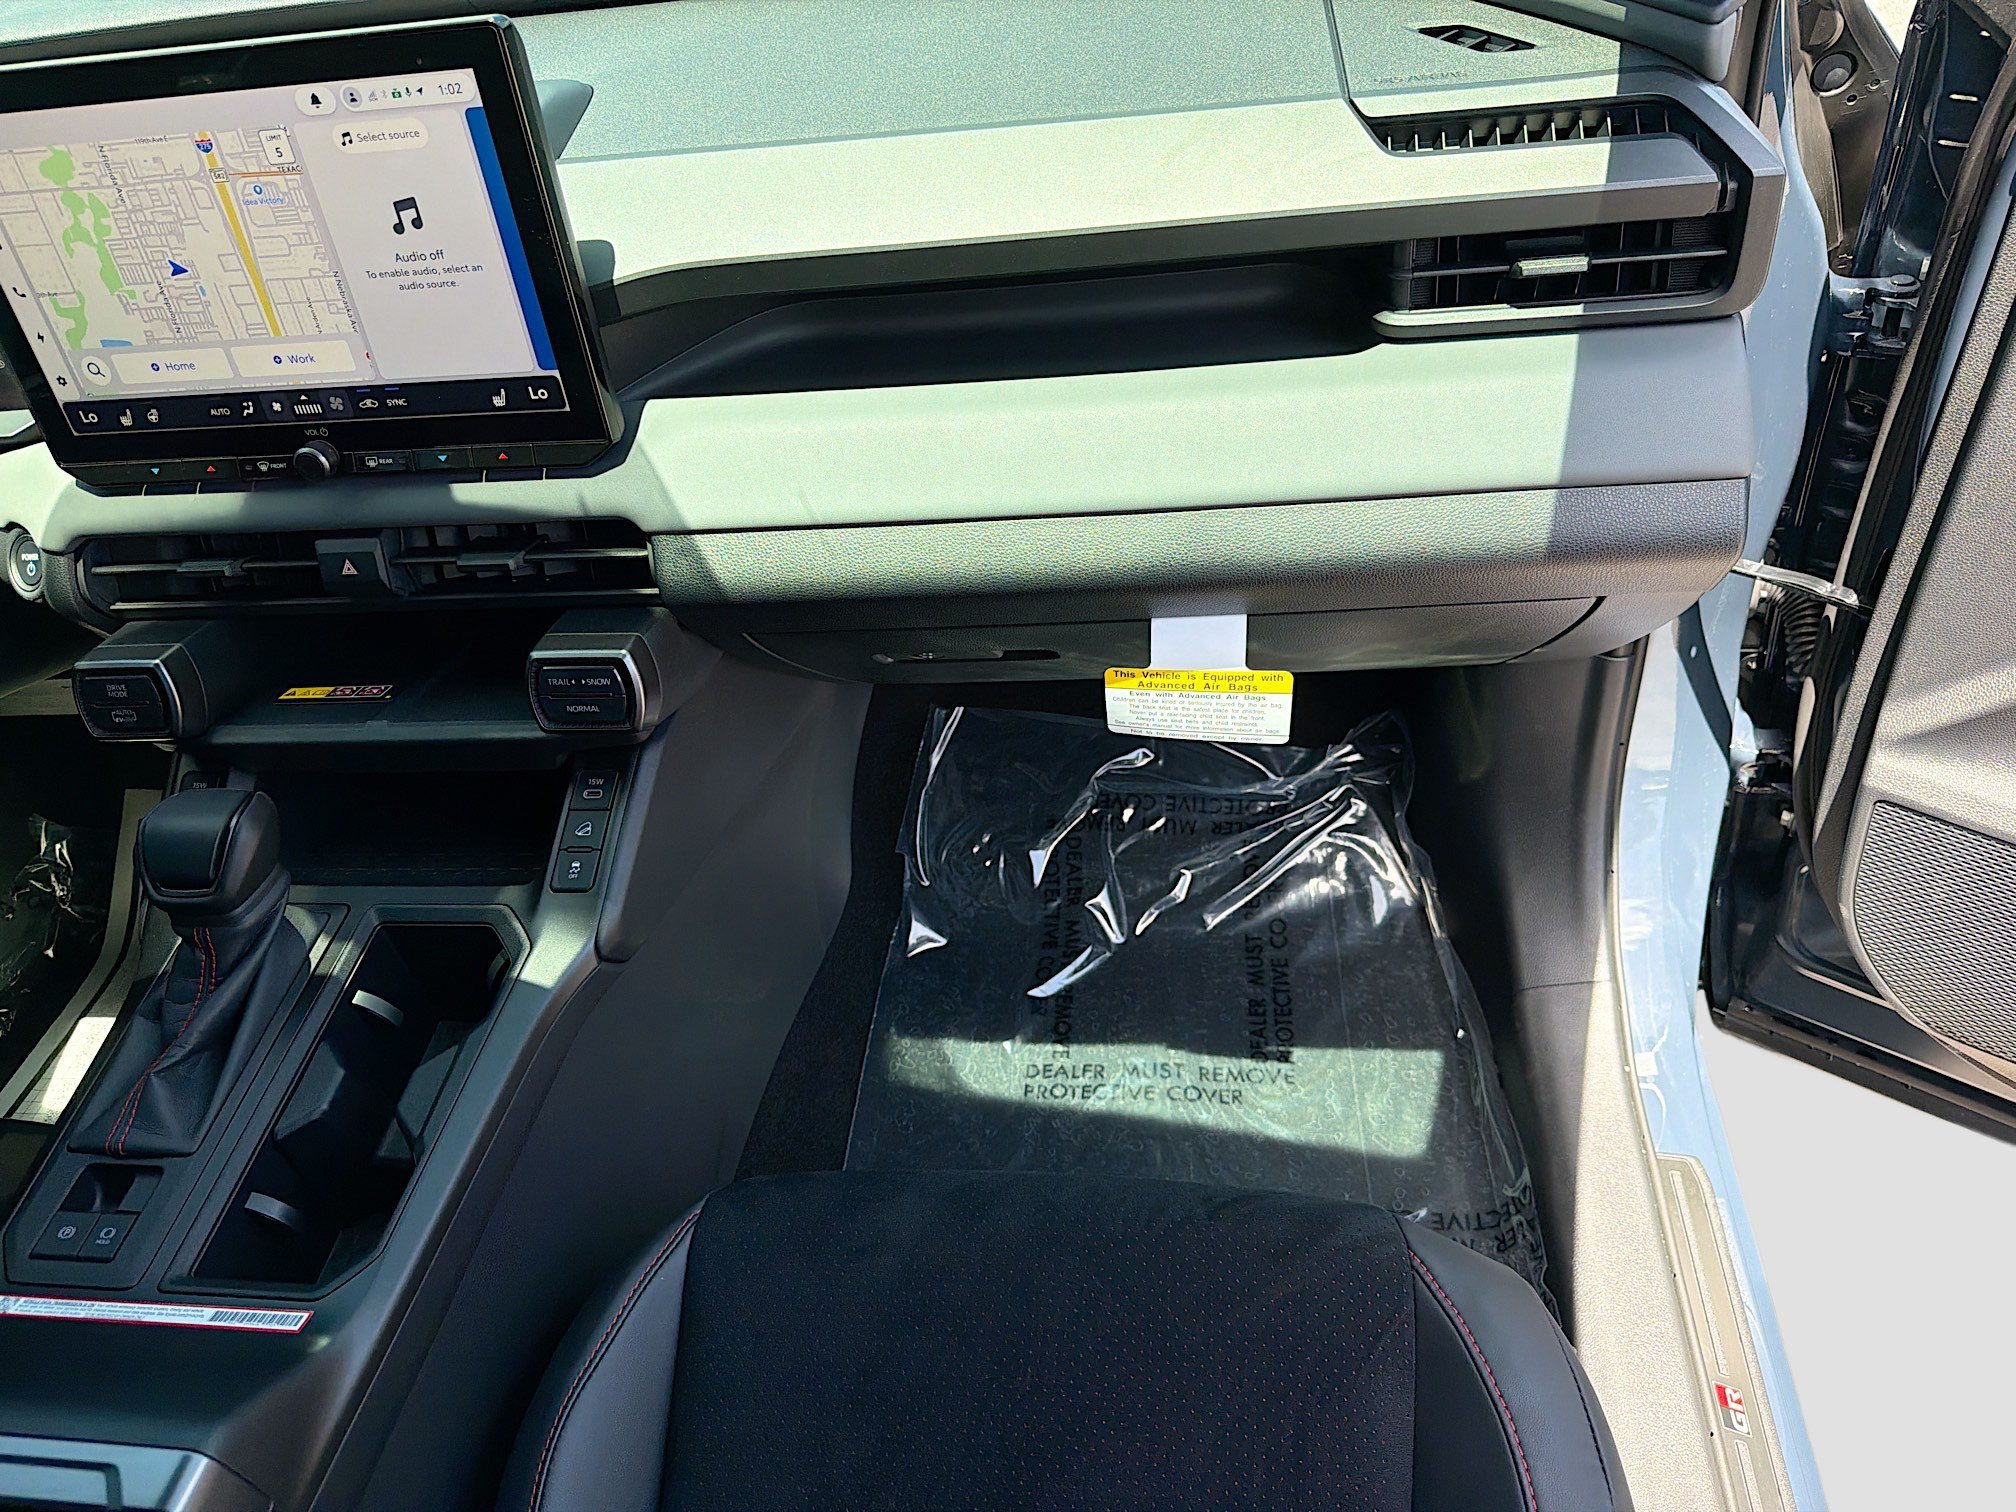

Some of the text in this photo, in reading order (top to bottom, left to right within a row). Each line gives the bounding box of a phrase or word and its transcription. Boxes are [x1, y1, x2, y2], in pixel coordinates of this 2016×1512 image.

[438, 82, 463, 96] 1:02
[265, 134, 281, 142] LIMIT
[356, 130, 420, 143] Select source
[275, 147, 283, 158] 5
[98, 145, 126, 204] N Florida Ave
[242, 197, 284, 206] Idea Victory
[395, 249, 445, 263] Audio off
[332, 270, 340, 278] N
[365, 270, 378, 279] To
[379, 268, 410, 279] enable
[411, 266, 441, 276] audio,
[442, 264, 470, 274] select
[156, 280, 167, 297] Ave
[398, 280, 460, 291] audio source.
[335, 279, 353, 318] Nebraska
[163, 297, 179, 326] Florida
[287, 353, 317, 364] Work
[164, 362, 197, 372] Home
[527, 386, 549, 400] Lo
[386, 398, 408, 407] SYNC
[78, 410, 99, 423] Lo
[210, 408, 231, 416] AUTO
[547, 678, 611, 686] TRAIL SNOW
[1113, 669, 1284, 683] This Vehicle is Equipped with
[1137, 680, 1258, 693] Advanced Air Bags
[107, 690, 129, 698] MODE
[1178, 692, 1221, 700] Advanced
[566, 705, 600, 713] NORMAL
[1142, 816, 1197, 835] MUT
[1052, 837, 1083, 1059] DEALER MUS REMOVE
[1244, 934, 1265, 986] MUST
[1031, 956, 1054, 1016] COER
[1269, 957, 1295, 1064] PROTECTIVE
[1247, 997, 1269, 1063] DEALER
[1024, 1061, 1296, 1085] DEALER MUST REMOVE
[1023, 1083, 1243, 1106] PROTECTIVE COVER
[1724, 1386, 1749, 1435] GR
